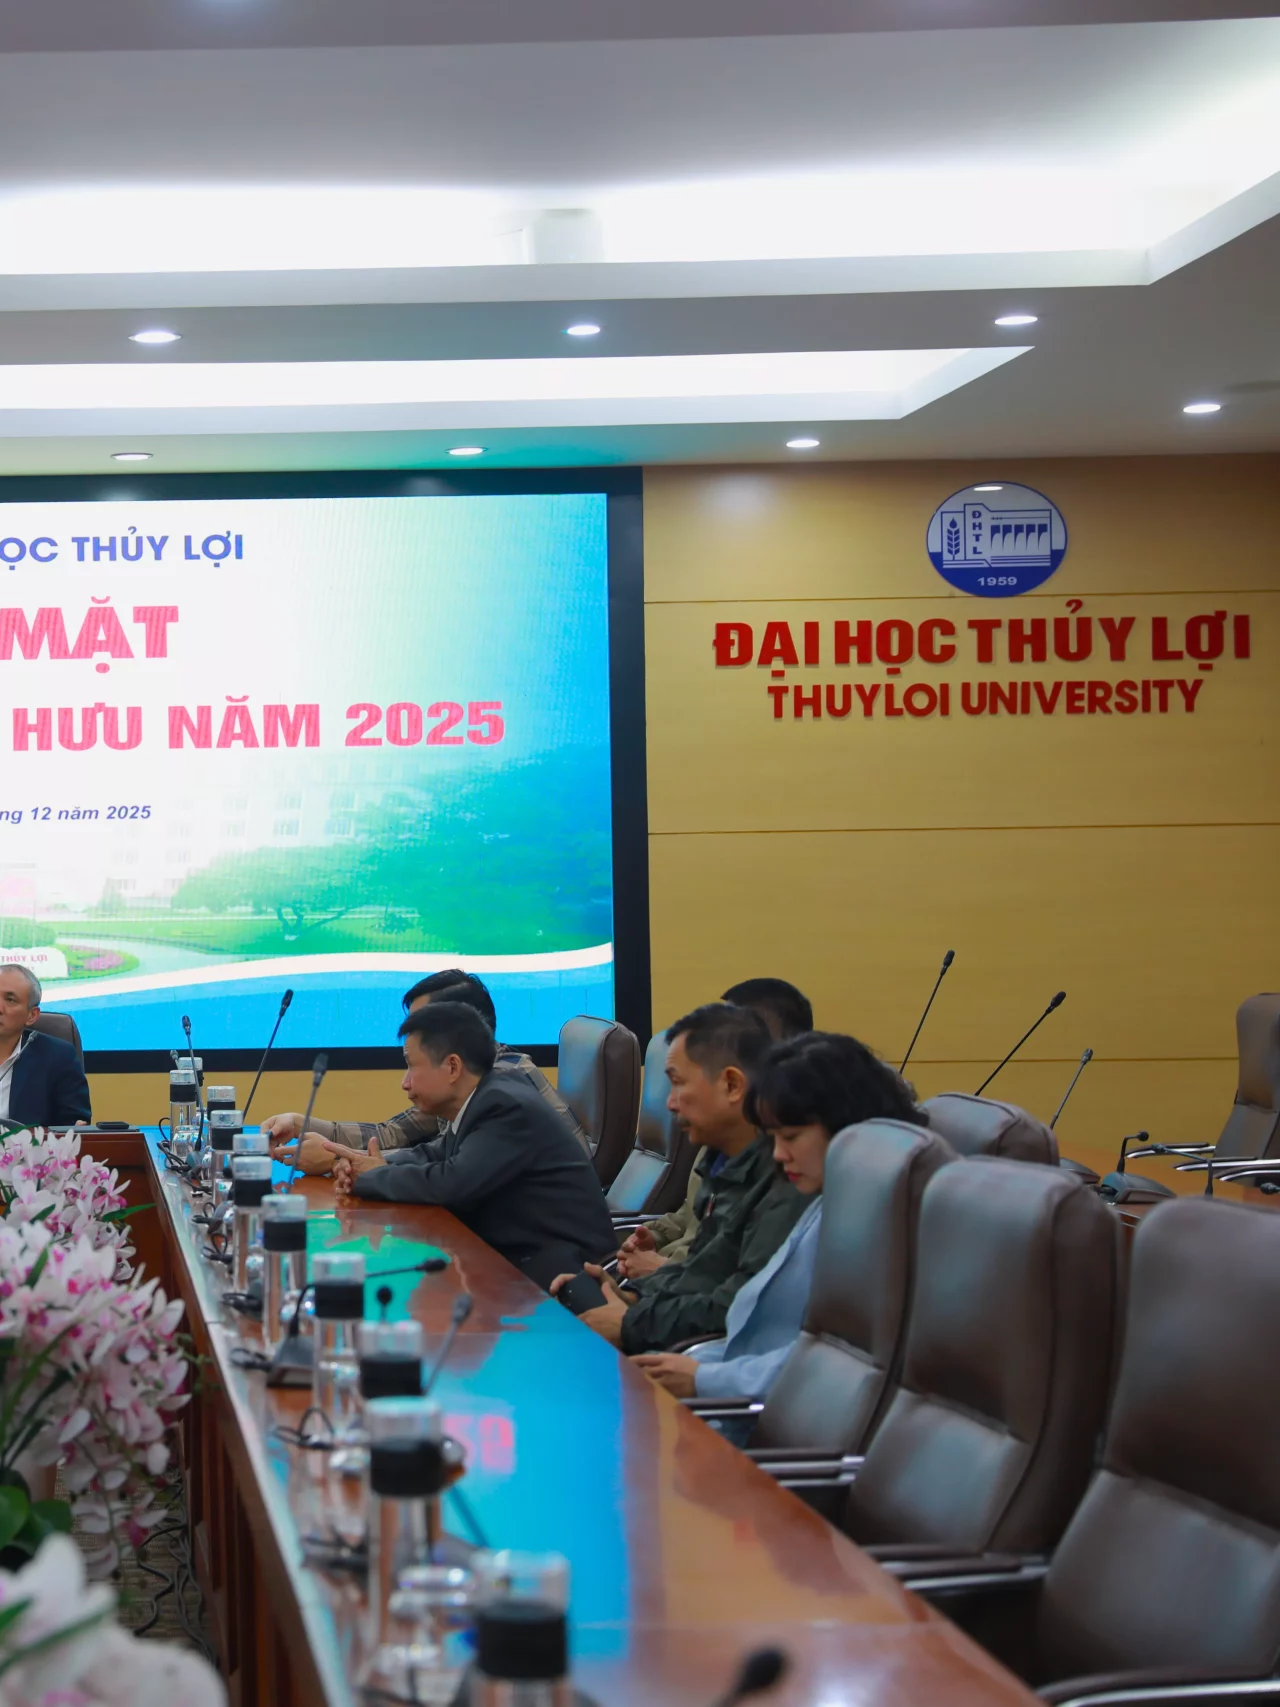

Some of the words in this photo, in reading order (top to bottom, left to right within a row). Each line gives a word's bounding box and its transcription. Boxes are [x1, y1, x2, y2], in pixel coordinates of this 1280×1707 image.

[71, 526, 169, 563] THỦY
[184, 530, 244, 568] LỢI
[977, 576, 1018, 586] 1959
[712, 621, 820, 678] ĐẠI
[834, 618, 956, 675] HỌC
[967, 599, 1136, 664] THỦY
[1151, 610, 1251, 671] LỢI
[961, 678, 1204, 716] UNIVERSITY
[12, 701, 143, 752] HƯU
[167, 694, 321, 750] NĂM
[344, 701, 506, 747] 2025
[30, 806, 52, 821] 12
[57, 806, 101, 820] năm
[106, 805, 153, 820] 2025
